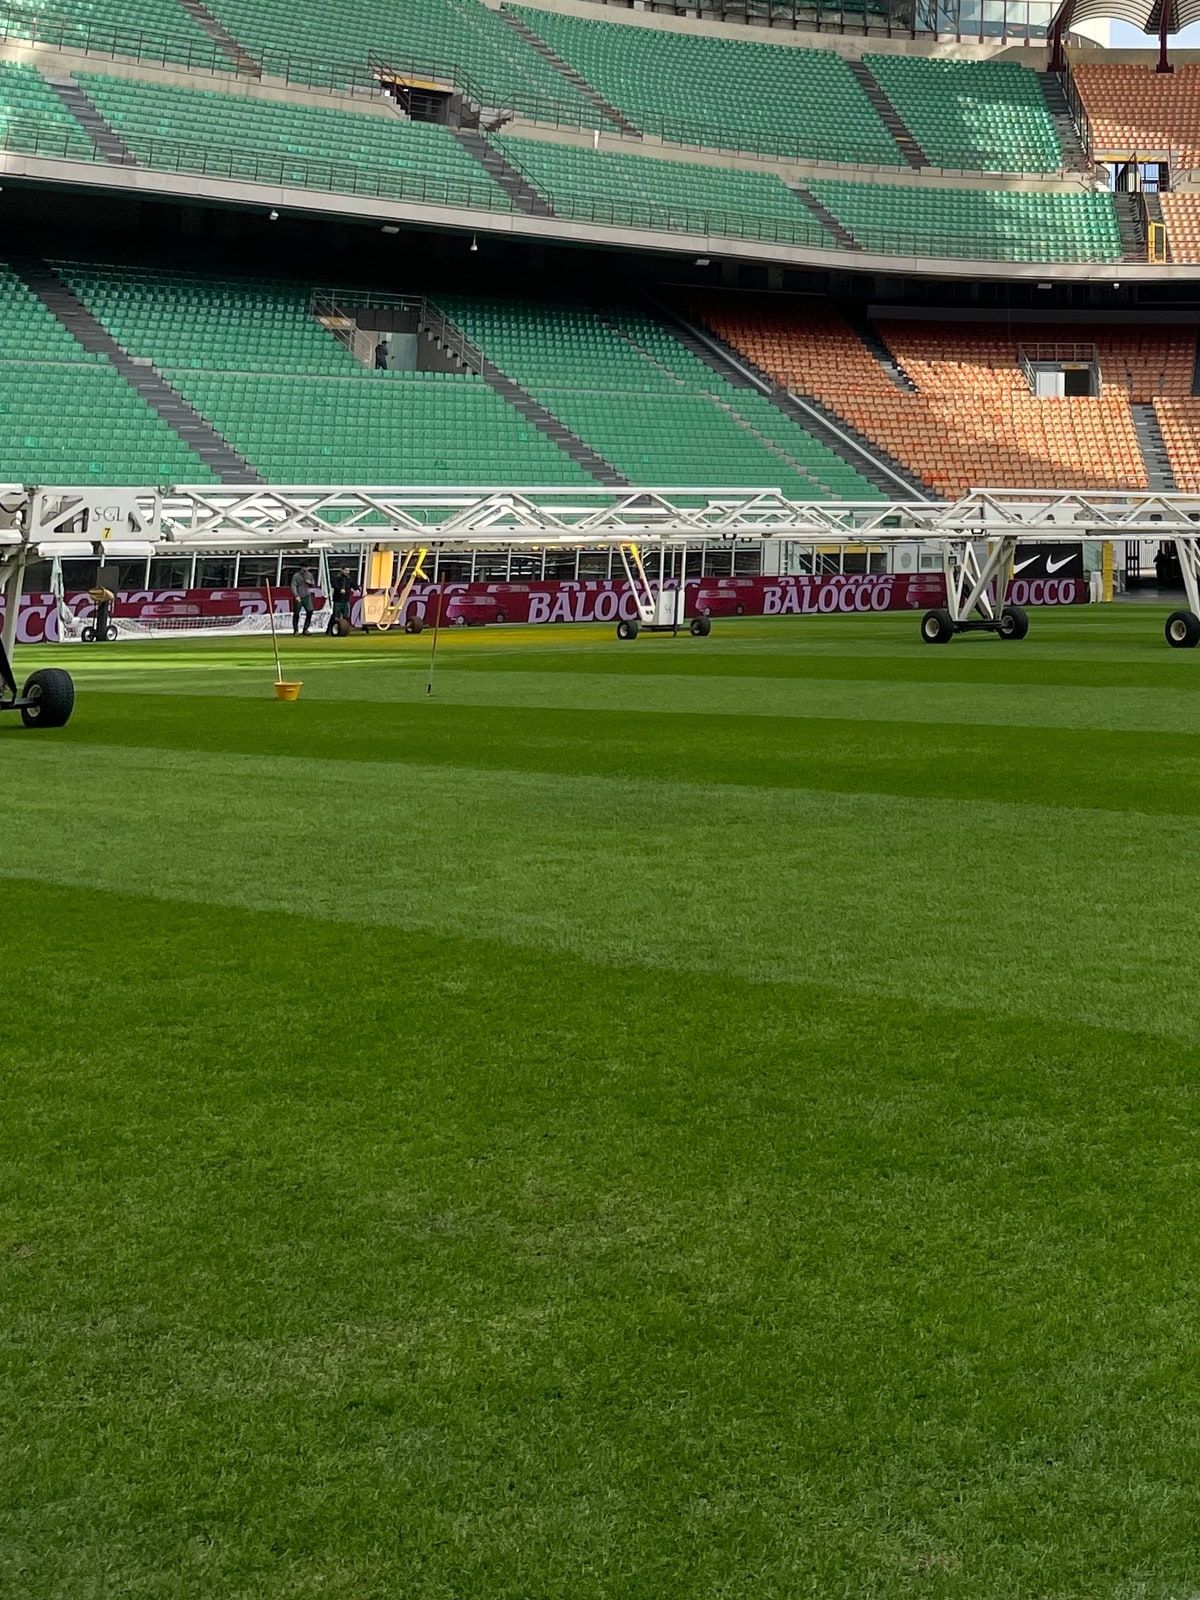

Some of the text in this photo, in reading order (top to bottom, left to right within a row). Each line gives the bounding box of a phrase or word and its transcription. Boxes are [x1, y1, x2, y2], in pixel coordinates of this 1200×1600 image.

[92, 506, 124, 522] SGL
[104, 528, 111, 538] 7
[763, 583, 893, 615] BALOCCO
